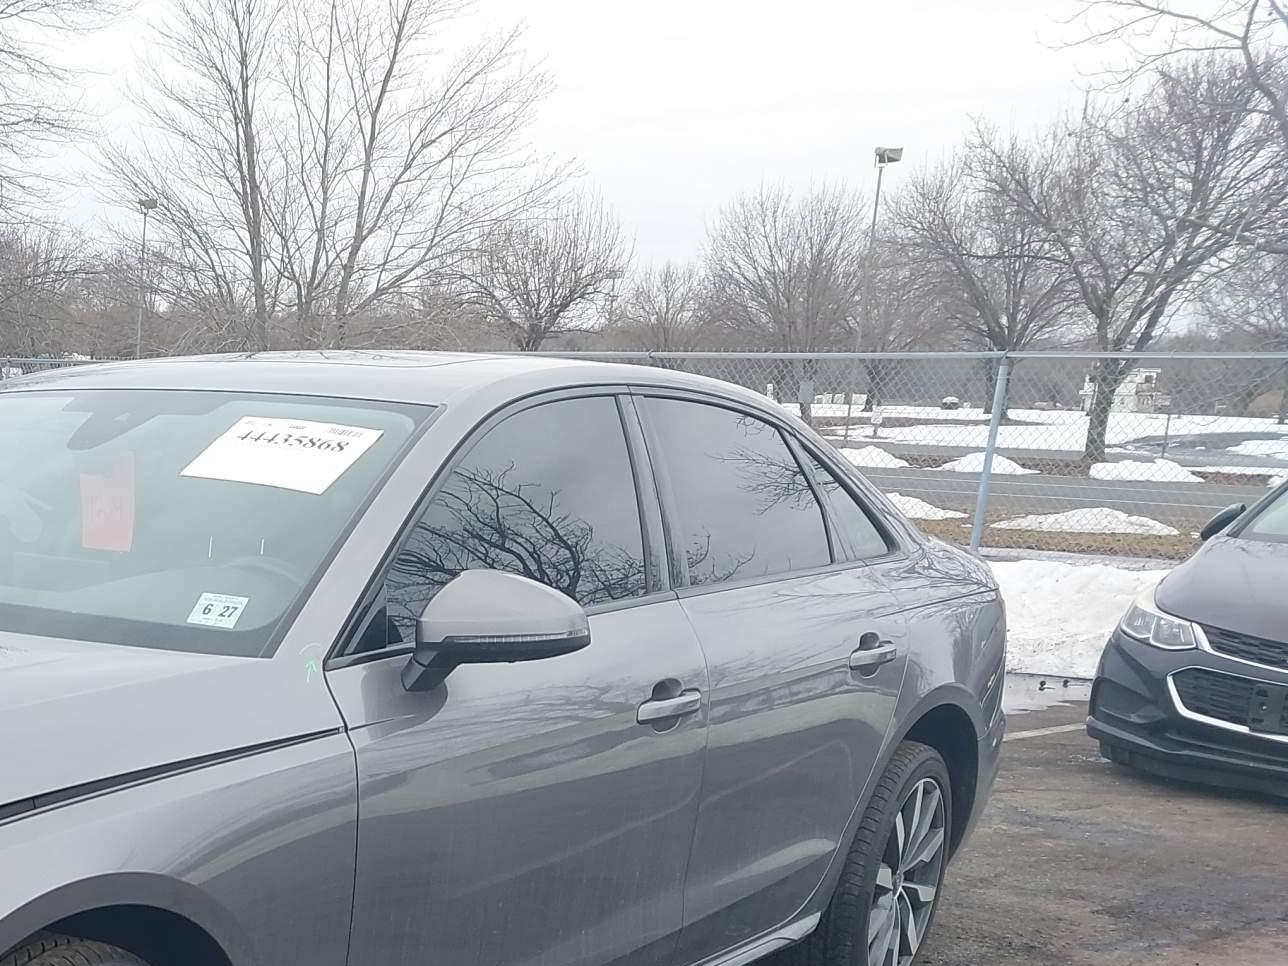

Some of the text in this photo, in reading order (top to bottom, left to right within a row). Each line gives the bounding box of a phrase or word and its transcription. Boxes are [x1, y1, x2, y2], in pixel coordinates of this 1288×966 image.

[237, 430, 350, 453] 44435868
[202, 603, 239, 618] 6 27
